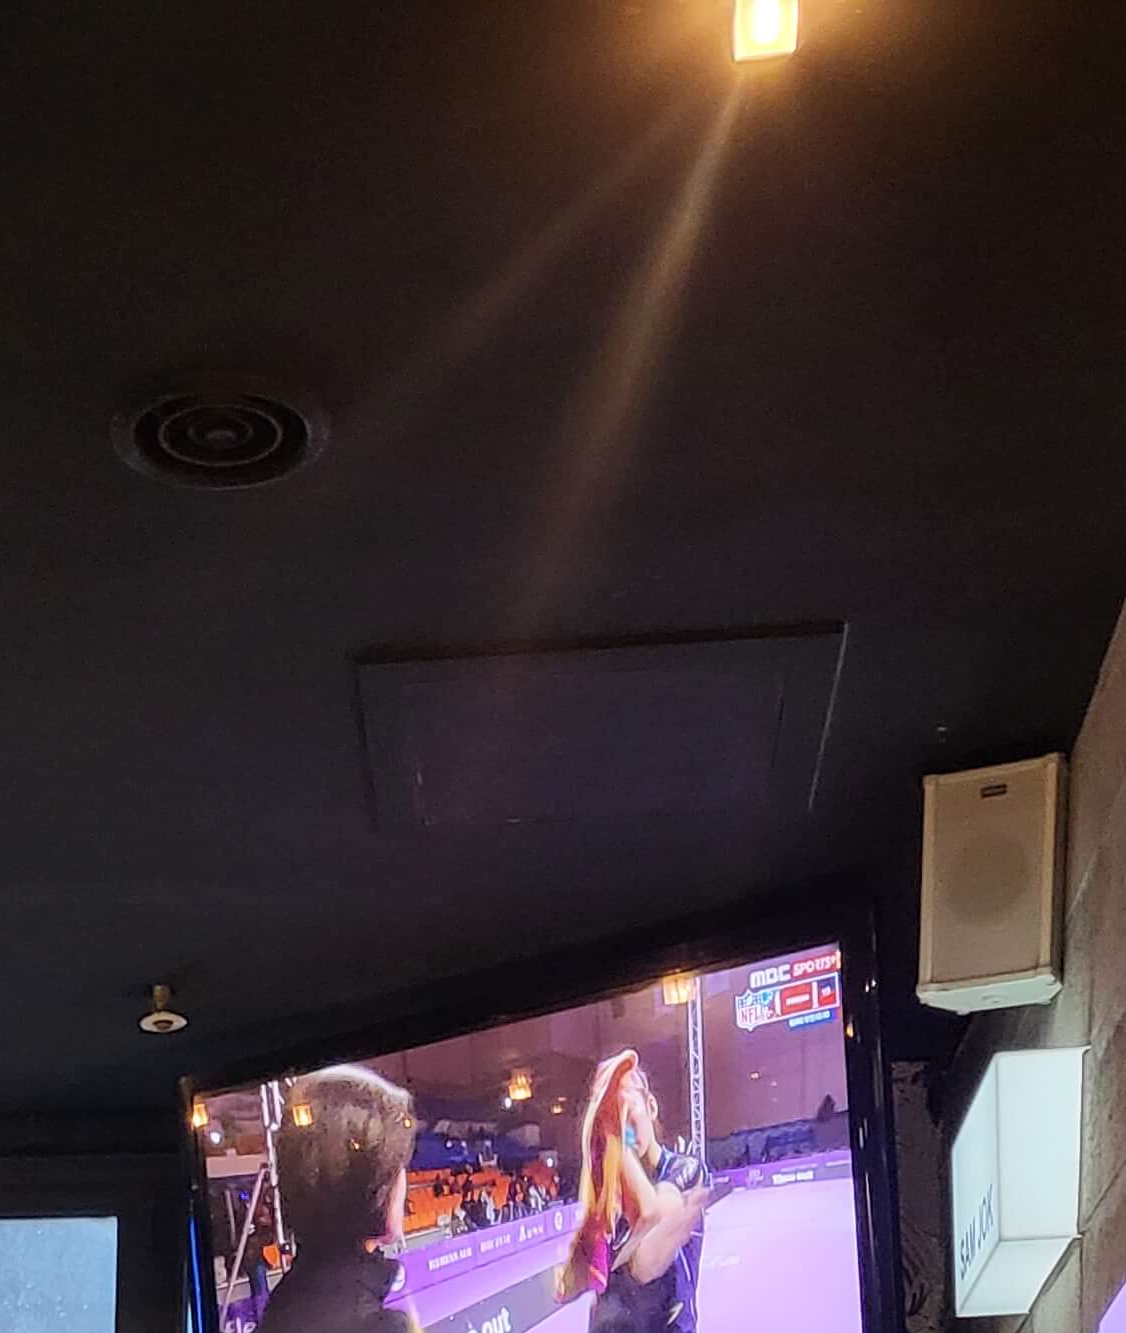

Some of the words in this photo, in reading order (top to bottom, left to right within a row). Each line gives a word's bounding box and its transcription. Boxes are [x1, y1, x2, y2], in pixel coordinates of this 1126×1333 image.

[749, 963, 792, 989] MBC
[740, 1004, 763, 1024] NFL
[960, 1215, 976, 1281] SAM
[977, 1183, 994, 1249] JOK
